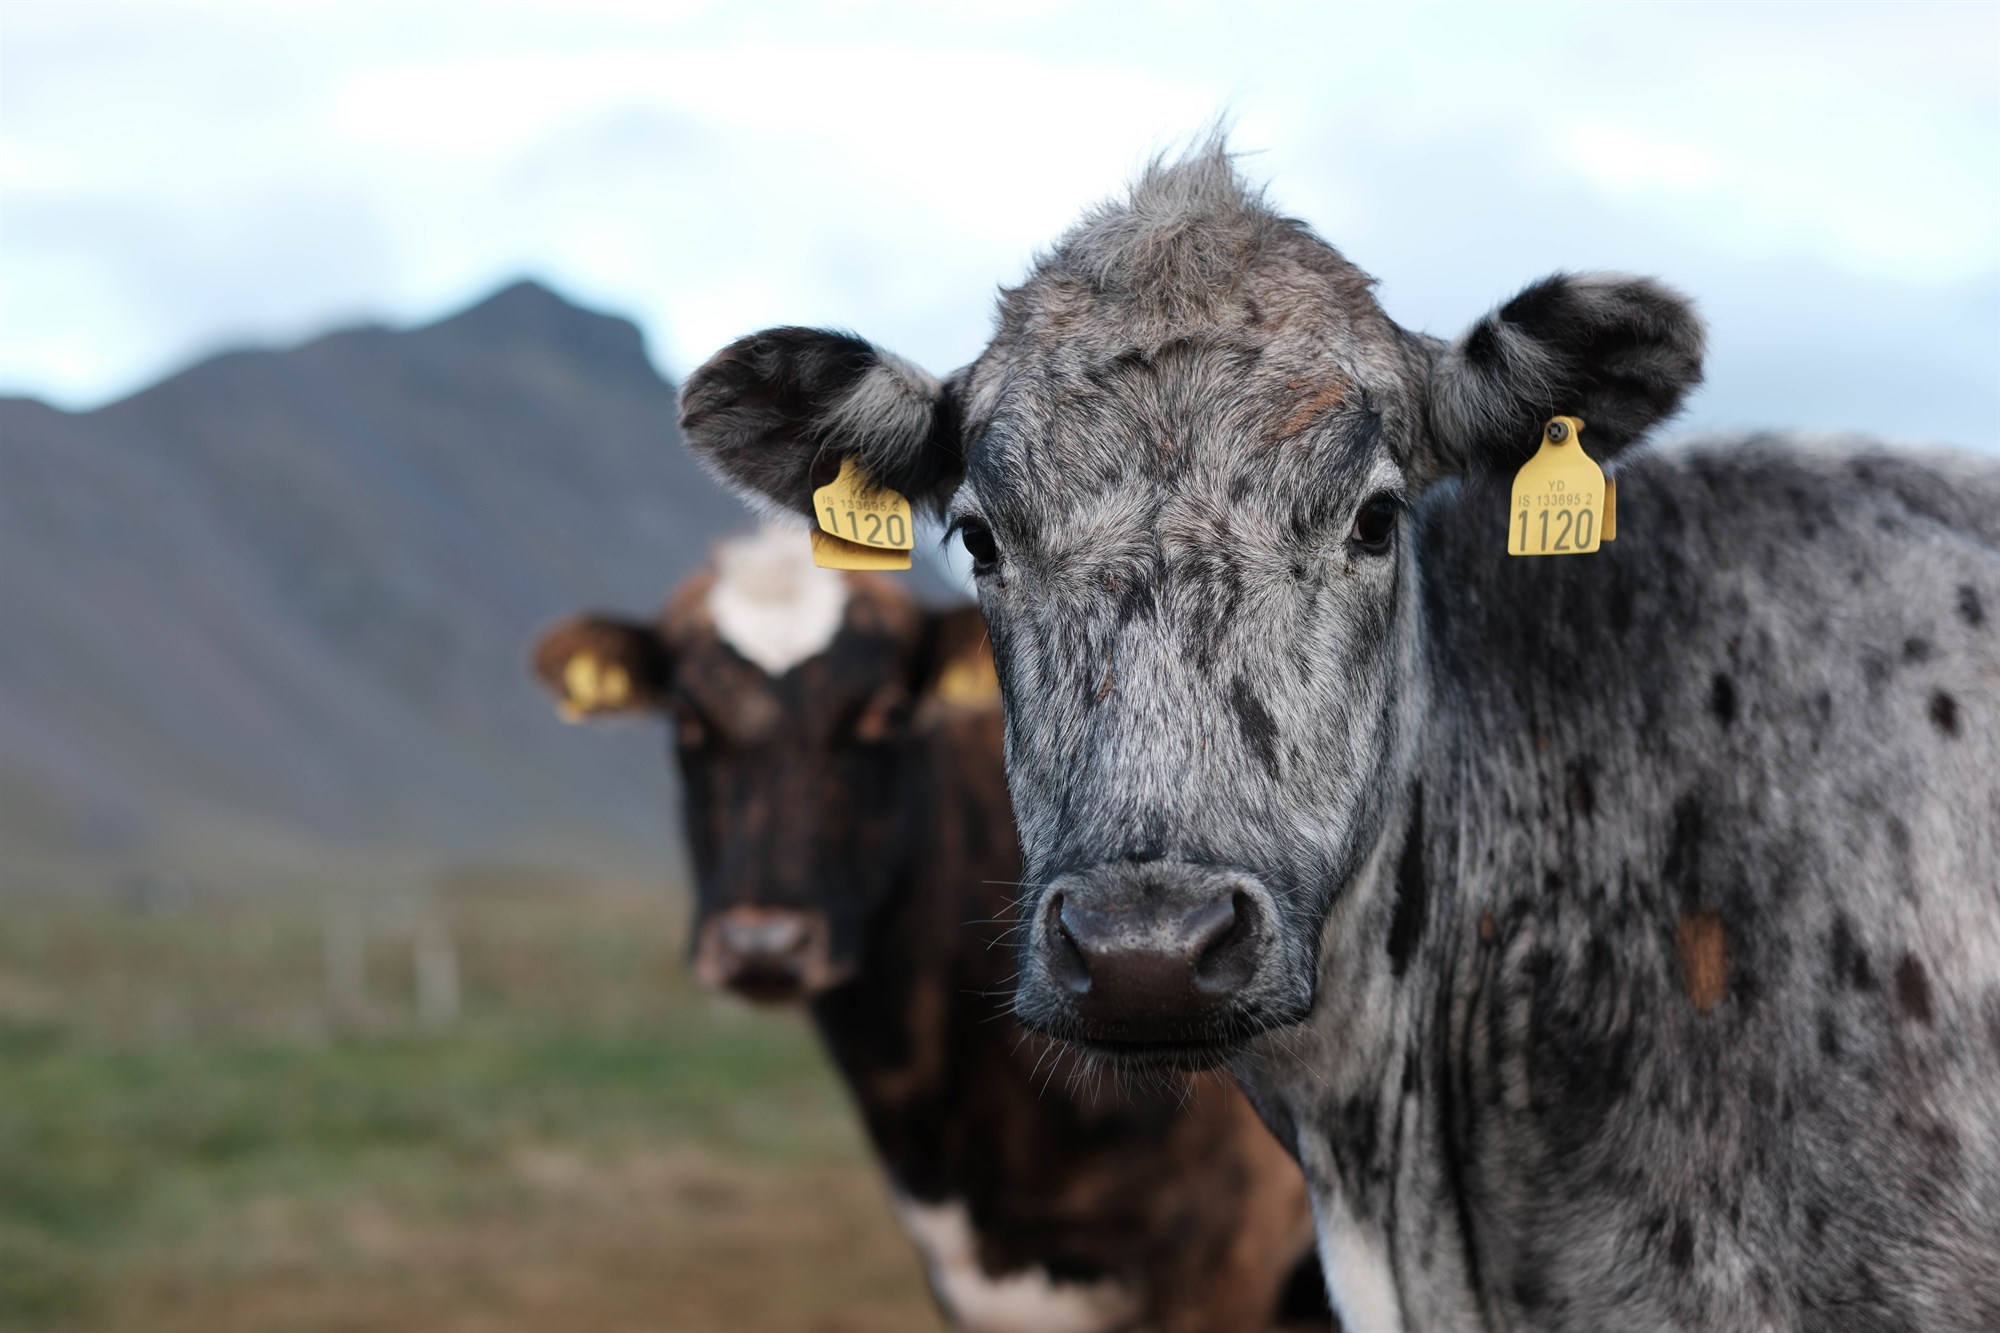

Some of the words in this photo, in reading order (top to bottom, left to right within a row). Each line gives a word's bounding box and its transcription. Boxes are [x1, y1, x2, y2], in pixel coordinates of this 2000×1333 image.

[1548, 480, 1565, 492] YD
[822, 495, 834, 506] IS
[841, 499, 887, 512] 133695
[892, 501, 900, 512] 2
[1518, 494, 1530, 507] IS
[1537, 494, 1581, 506] 133695
[1585, 492, 1593, 506] 2
[825, 506, 906, 547] 1120
[1518, 508, 1594, 552] 1120
